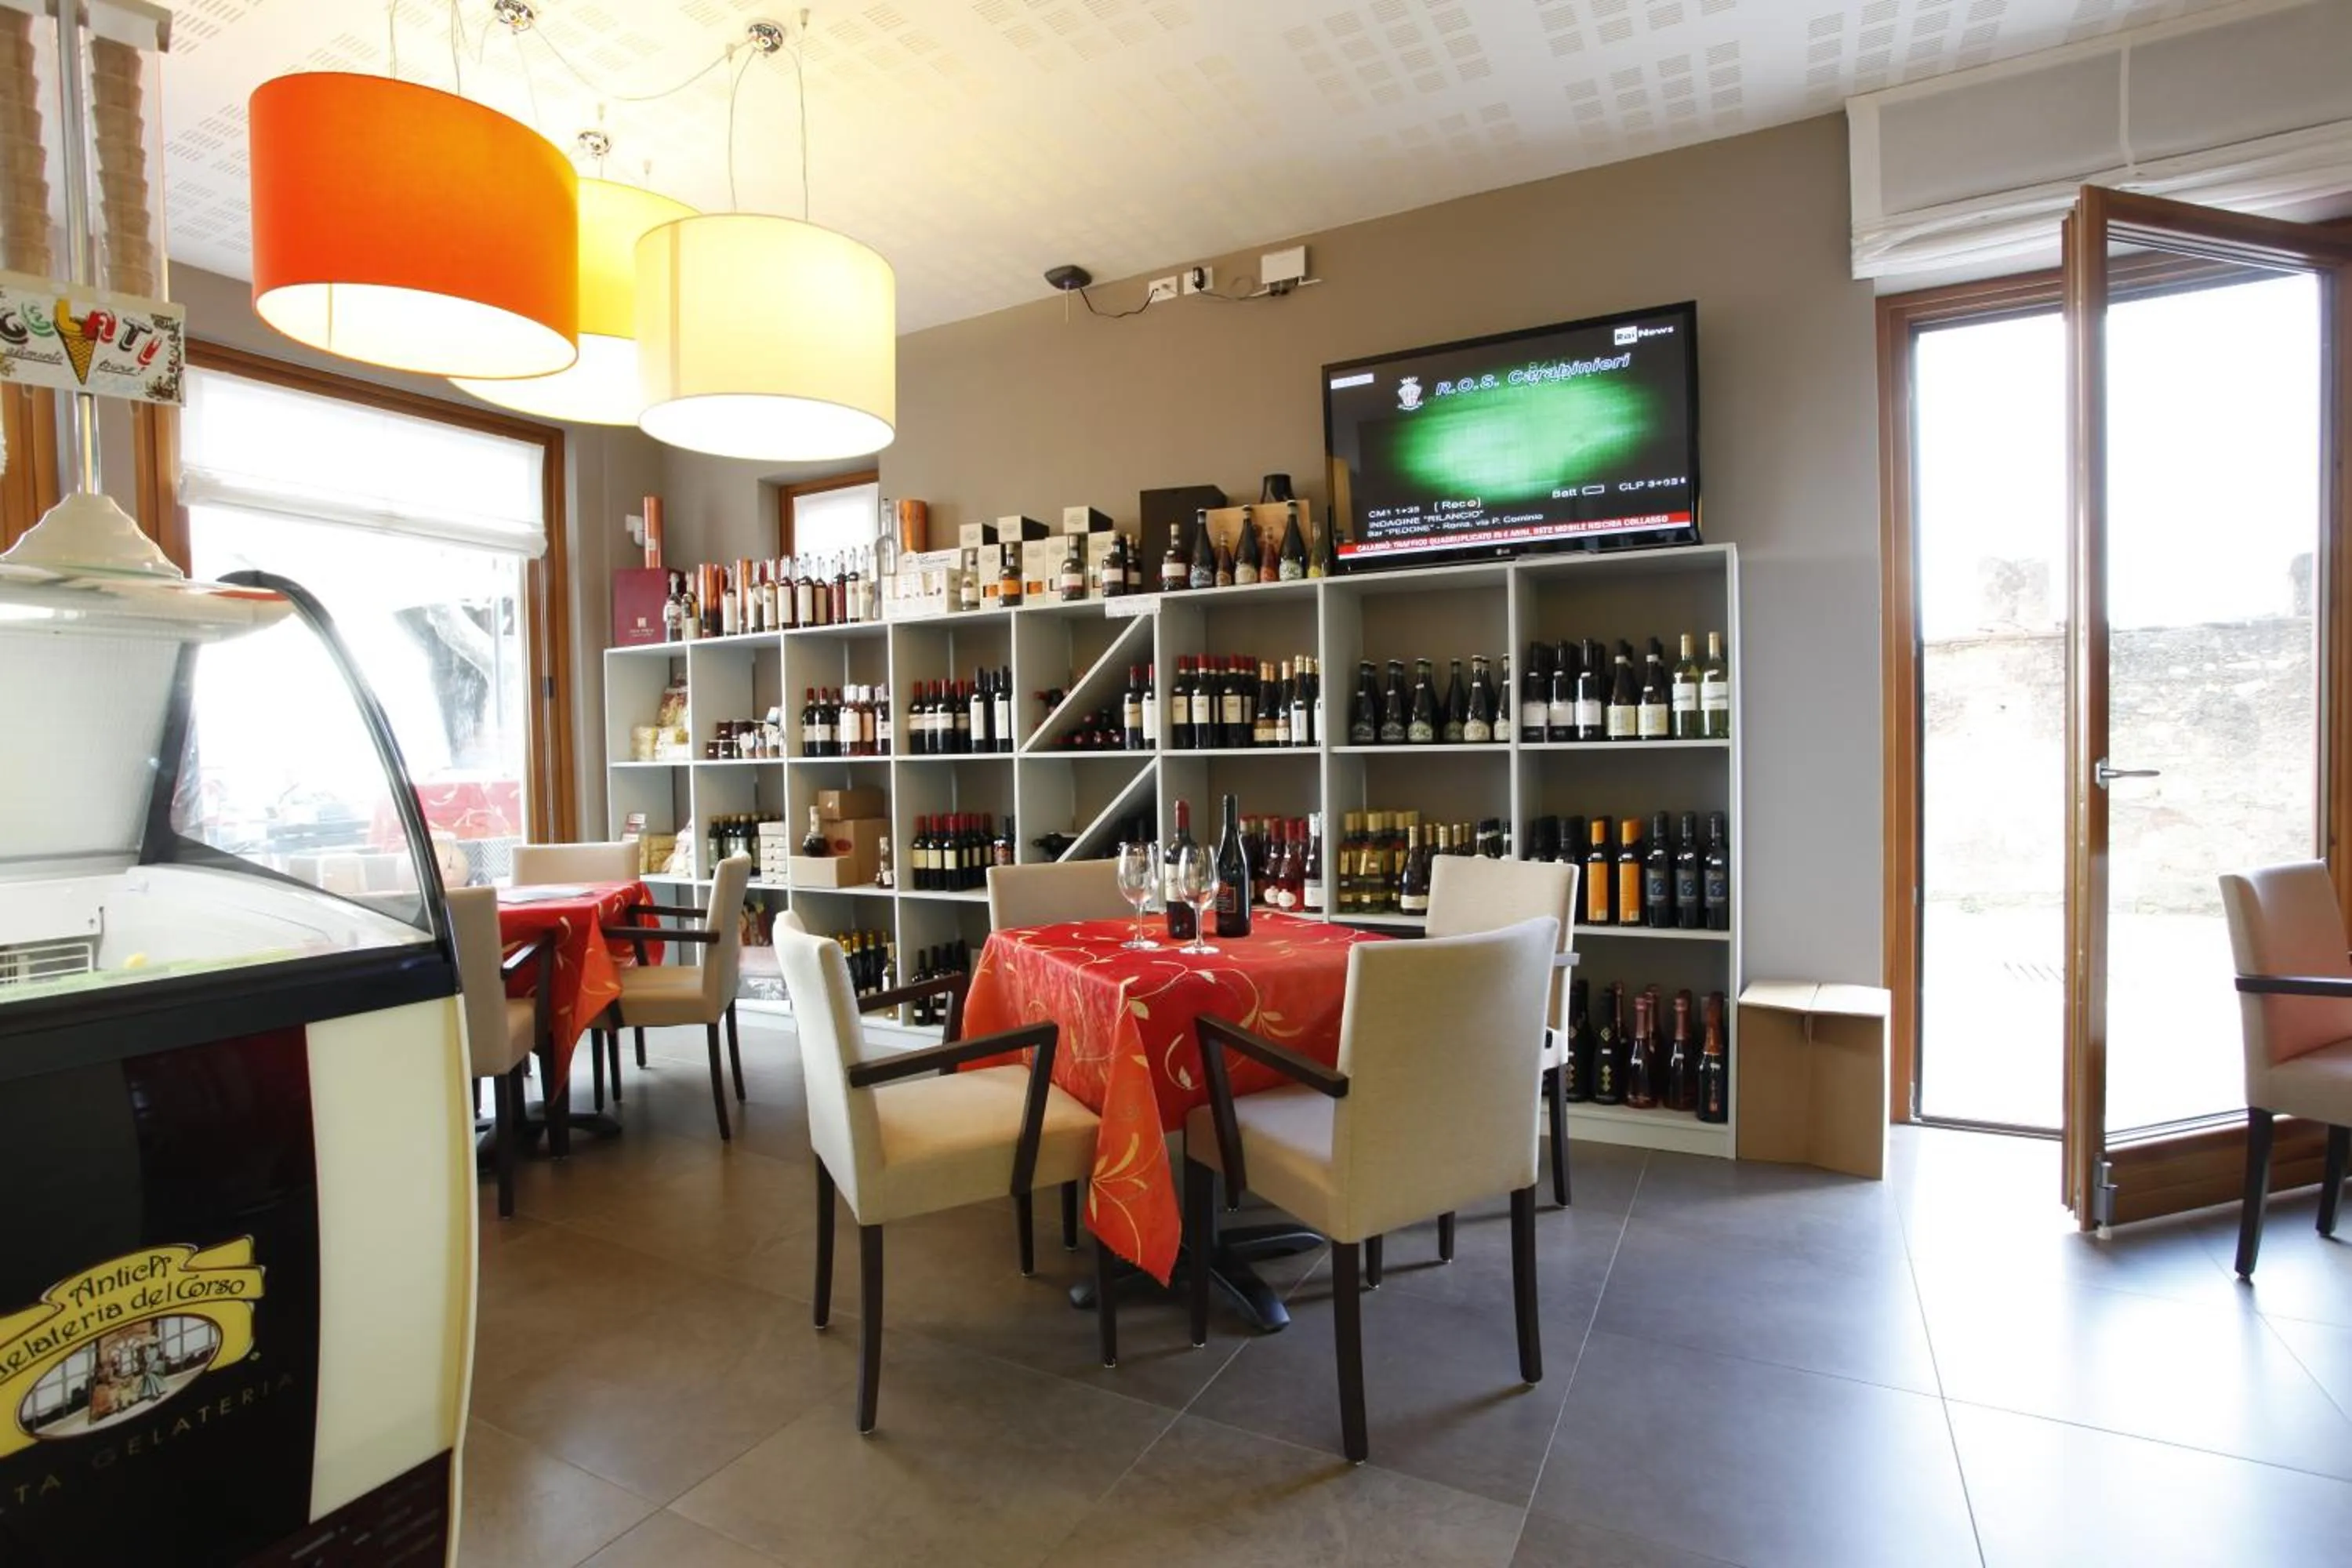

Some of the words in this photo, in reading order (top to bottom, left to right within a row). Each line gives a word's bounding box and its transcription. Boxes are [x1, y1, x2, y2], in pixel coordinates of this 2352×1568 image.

[1638, 325, 1675, 337] News
[1436, 374, 1501, 396] R.O.S.
[1552, 488, 1577, 499] Batt
[1619, 481, 1645, 492] CLP
[1367, 528, 1383, 538] Bar
[1475, 517, 1489, 526] via
[1369, 517, 1421, 528] INDAGINE
[1392, 539, 1428, 548] TRAFFICO
[1555, 521, 1586, 533] MOBILE
[1588, 517, 1622, 530] RISCHIA
[1624, 514, 1669, 527] COLLASSO
[131, 1283, 172, 1312] del
[176, 1275, 245, 1300] Corso
[92, 1372, 294, 1469] GELATERIA
